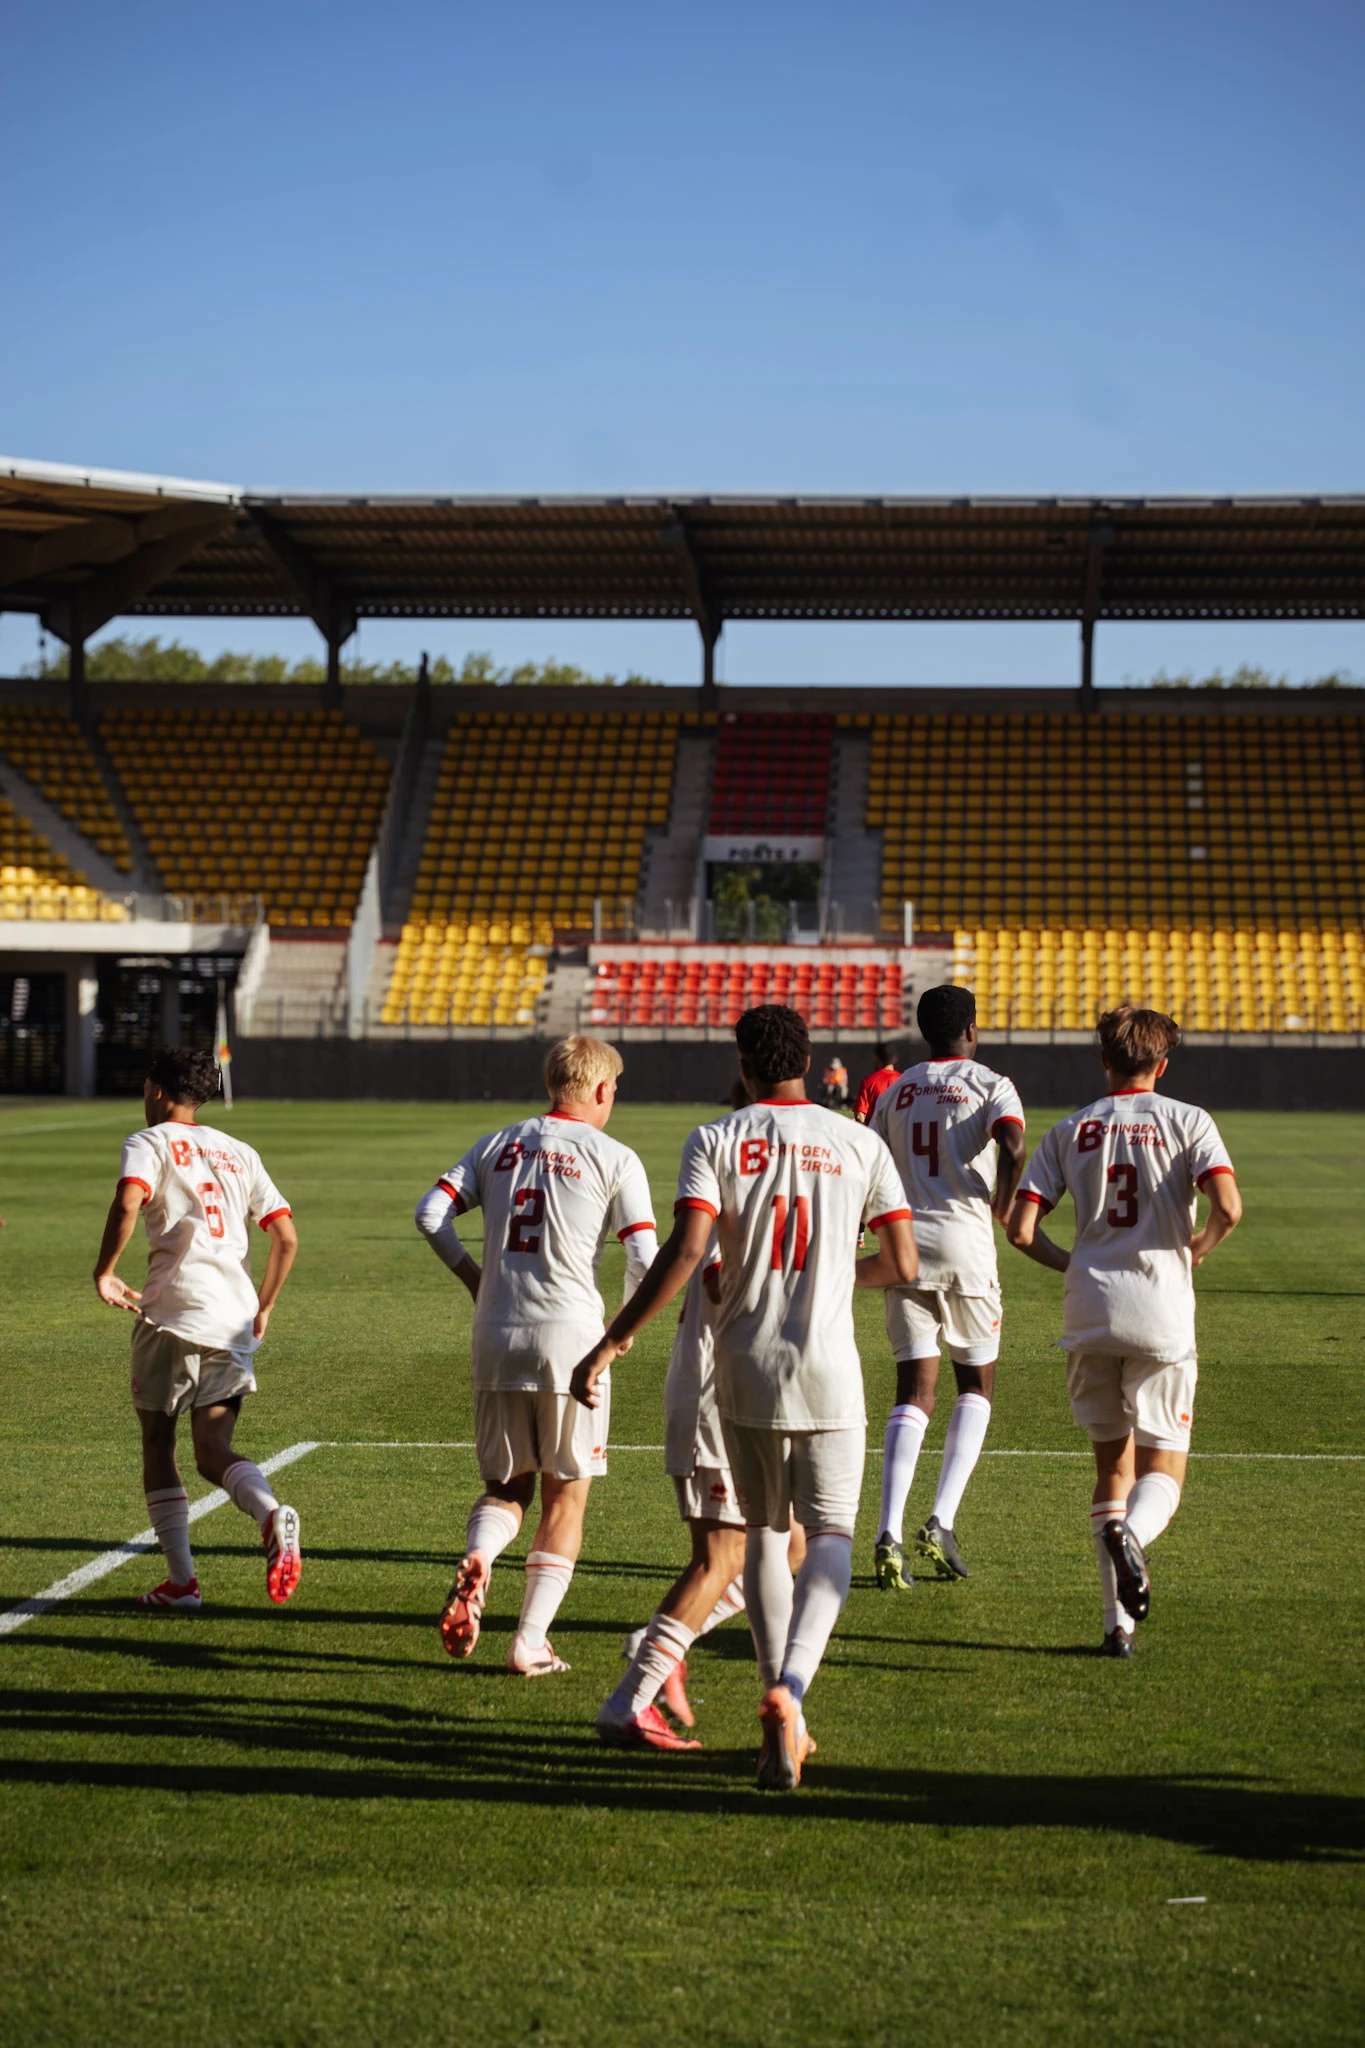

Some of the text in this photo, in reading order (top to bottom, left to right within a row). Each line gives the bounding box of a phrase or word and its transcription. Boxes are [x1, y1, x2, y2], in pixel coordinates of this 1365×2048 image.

[895, 1083, 963, 1112] BORINGEN
[936, 1094, 969, 1105] ZIRDA
[912, 1121, 939, 1177] 4
[1078, 1119, 1159, 1154] BORINGEN
[1127, 1135, 1165, 1147] ZIRDA
[494, 1141, 577, 1172] BORINGEN
[542, 1162, 581, 1179] ZIRDA
[739, 1138, 832, 1176] BORINGEN
[799, 1159, 842, 1176] ZIRDA
[196, 1182, 225, 1239] 6
[1107, 1163, 1138, 1228] 3
[508, 1187, 546, 1253] 2
[771, 1194, 809, 1271] 11
